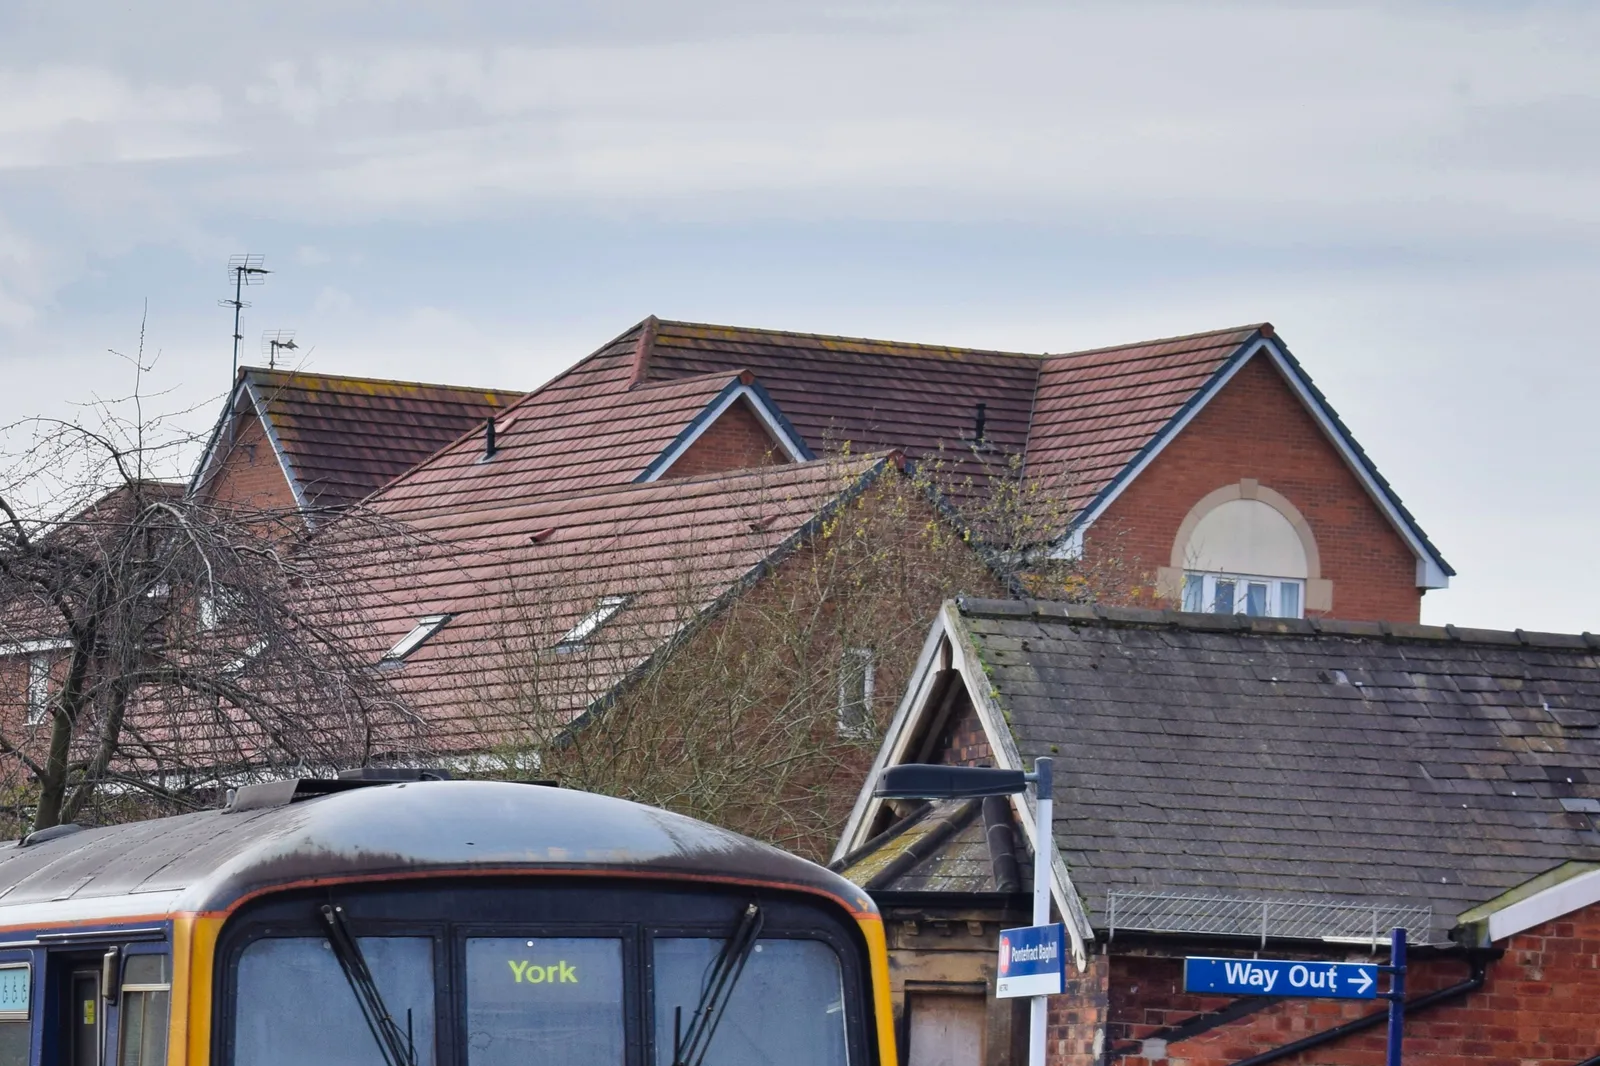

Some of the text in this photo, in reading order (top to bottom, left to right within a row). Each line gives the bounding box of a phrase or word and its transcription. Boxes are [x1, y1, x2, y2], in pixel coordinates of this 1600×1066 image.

[1012, 942, 1057, 963] Pontefract Baghill
[507, 960, 578, 984] York
[1224, 962, 1338, 992] Way Out
